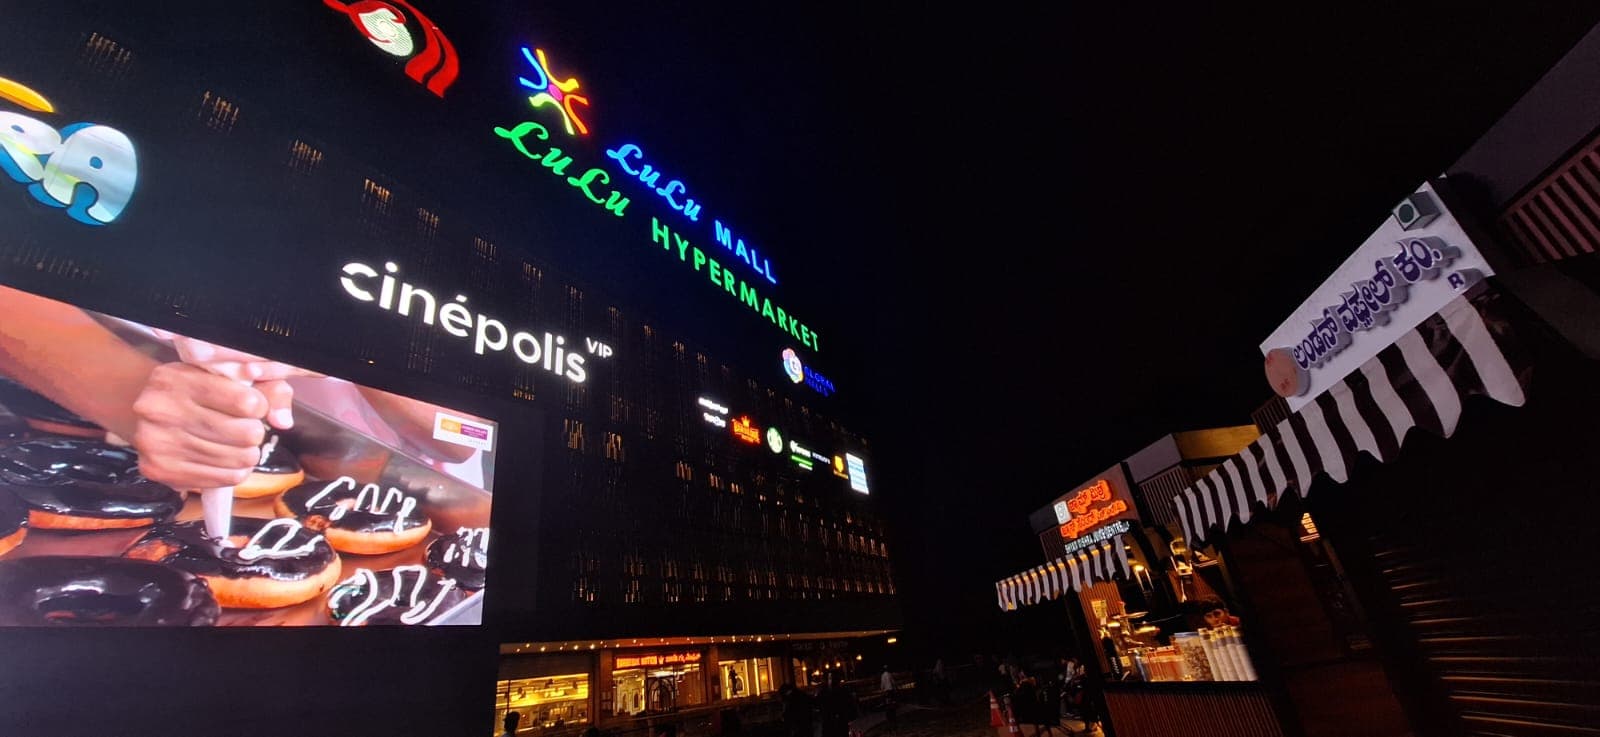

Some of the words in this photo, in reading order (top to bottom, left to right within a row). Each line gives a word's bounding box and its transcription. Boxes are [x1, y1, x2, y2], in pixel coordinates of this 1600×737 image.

[652, 217, 819, 352] HYPERMARKET
[714, 219, 777, 285] MALL
[340, 261, 587, 383] cinépolis
[585, 336, 614, 359] VIP
